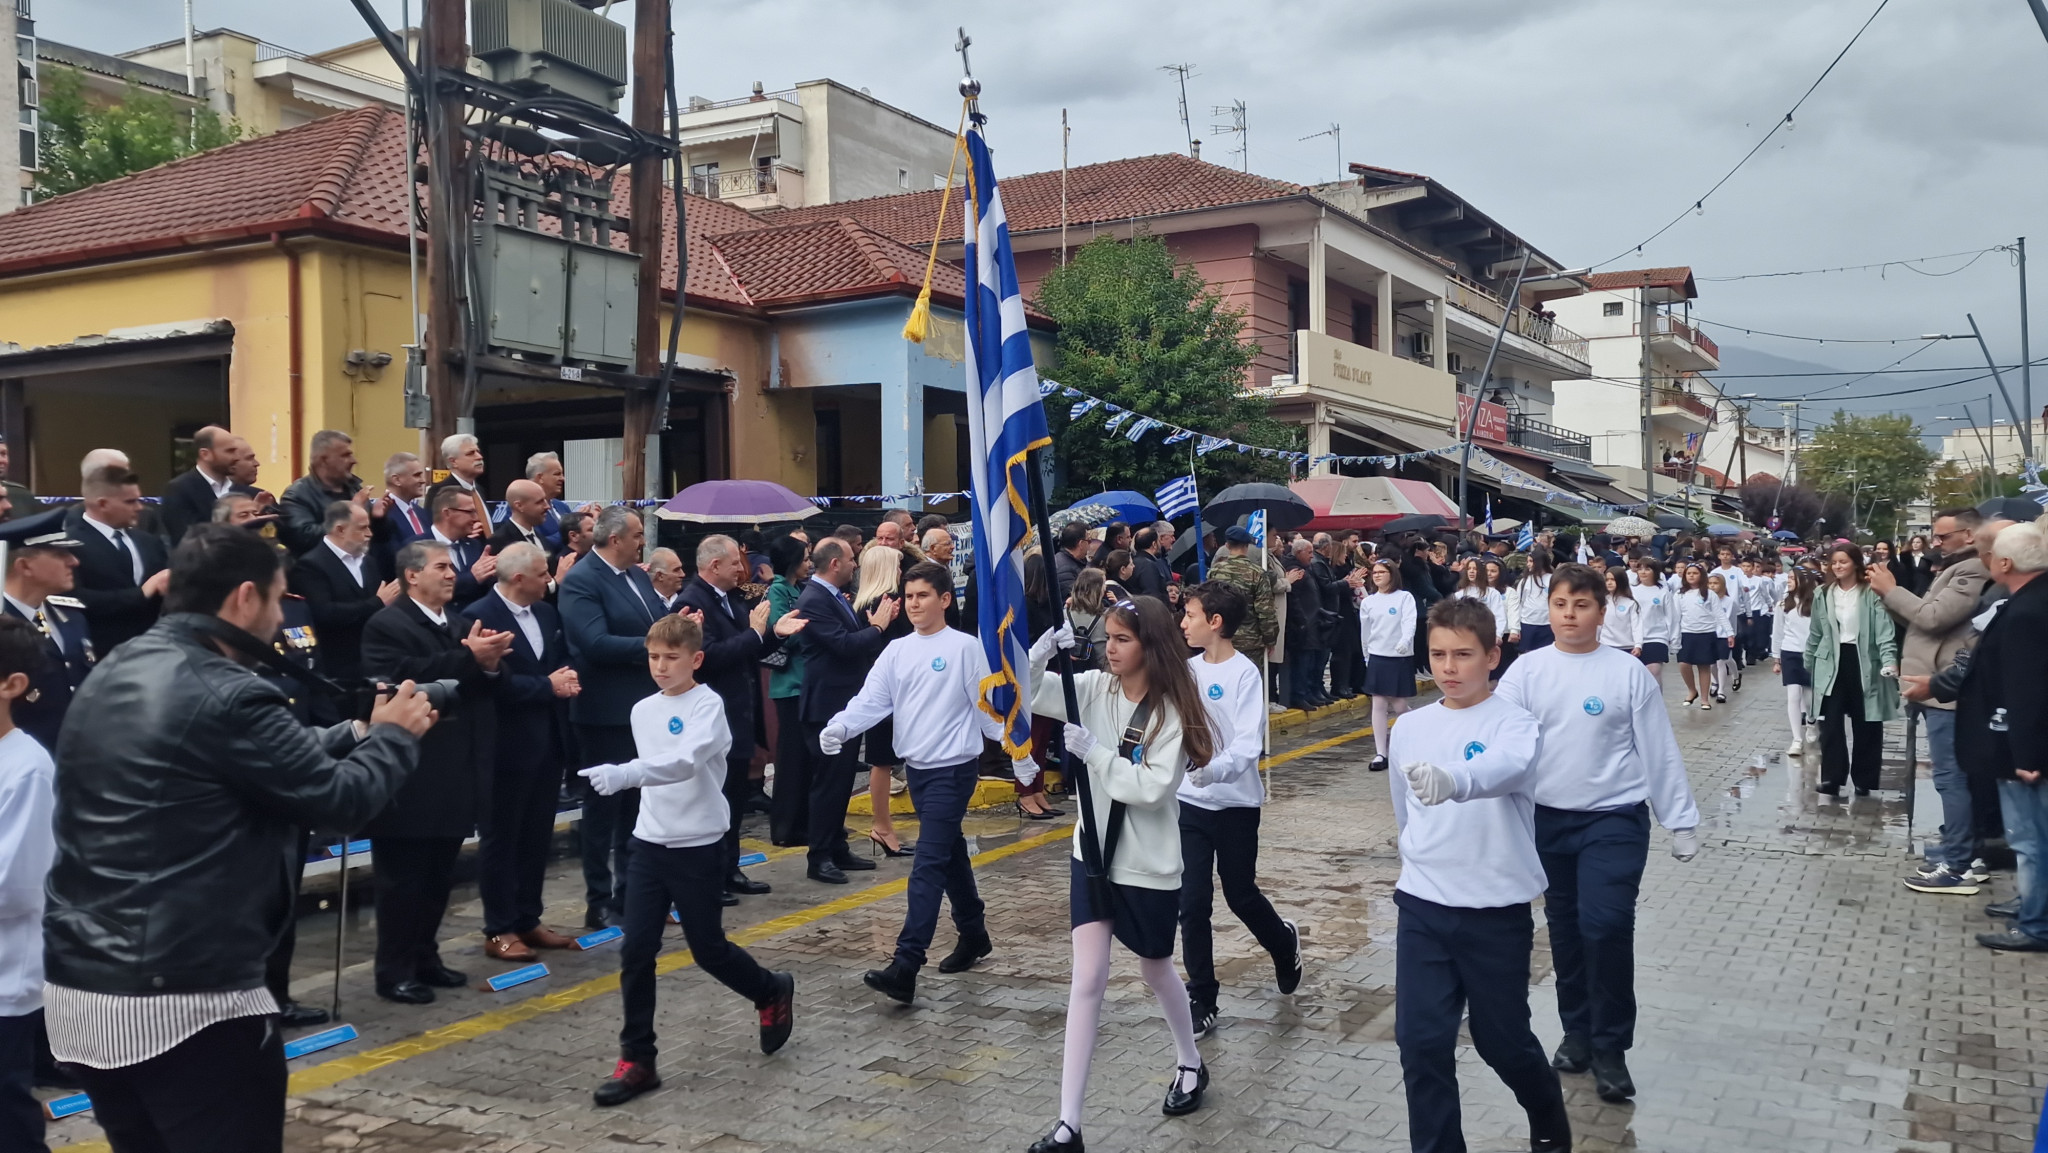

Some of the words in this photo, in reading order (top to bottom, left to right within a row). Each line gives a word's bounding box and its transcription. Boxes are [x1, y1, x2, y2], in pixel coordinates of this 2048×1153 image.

[1333, 362, 1351, 381] PIZZA
[1352, 367, 1372, 385] PLACE
[1458, 396, 1494, 430] ΣΥΙΖΑ
